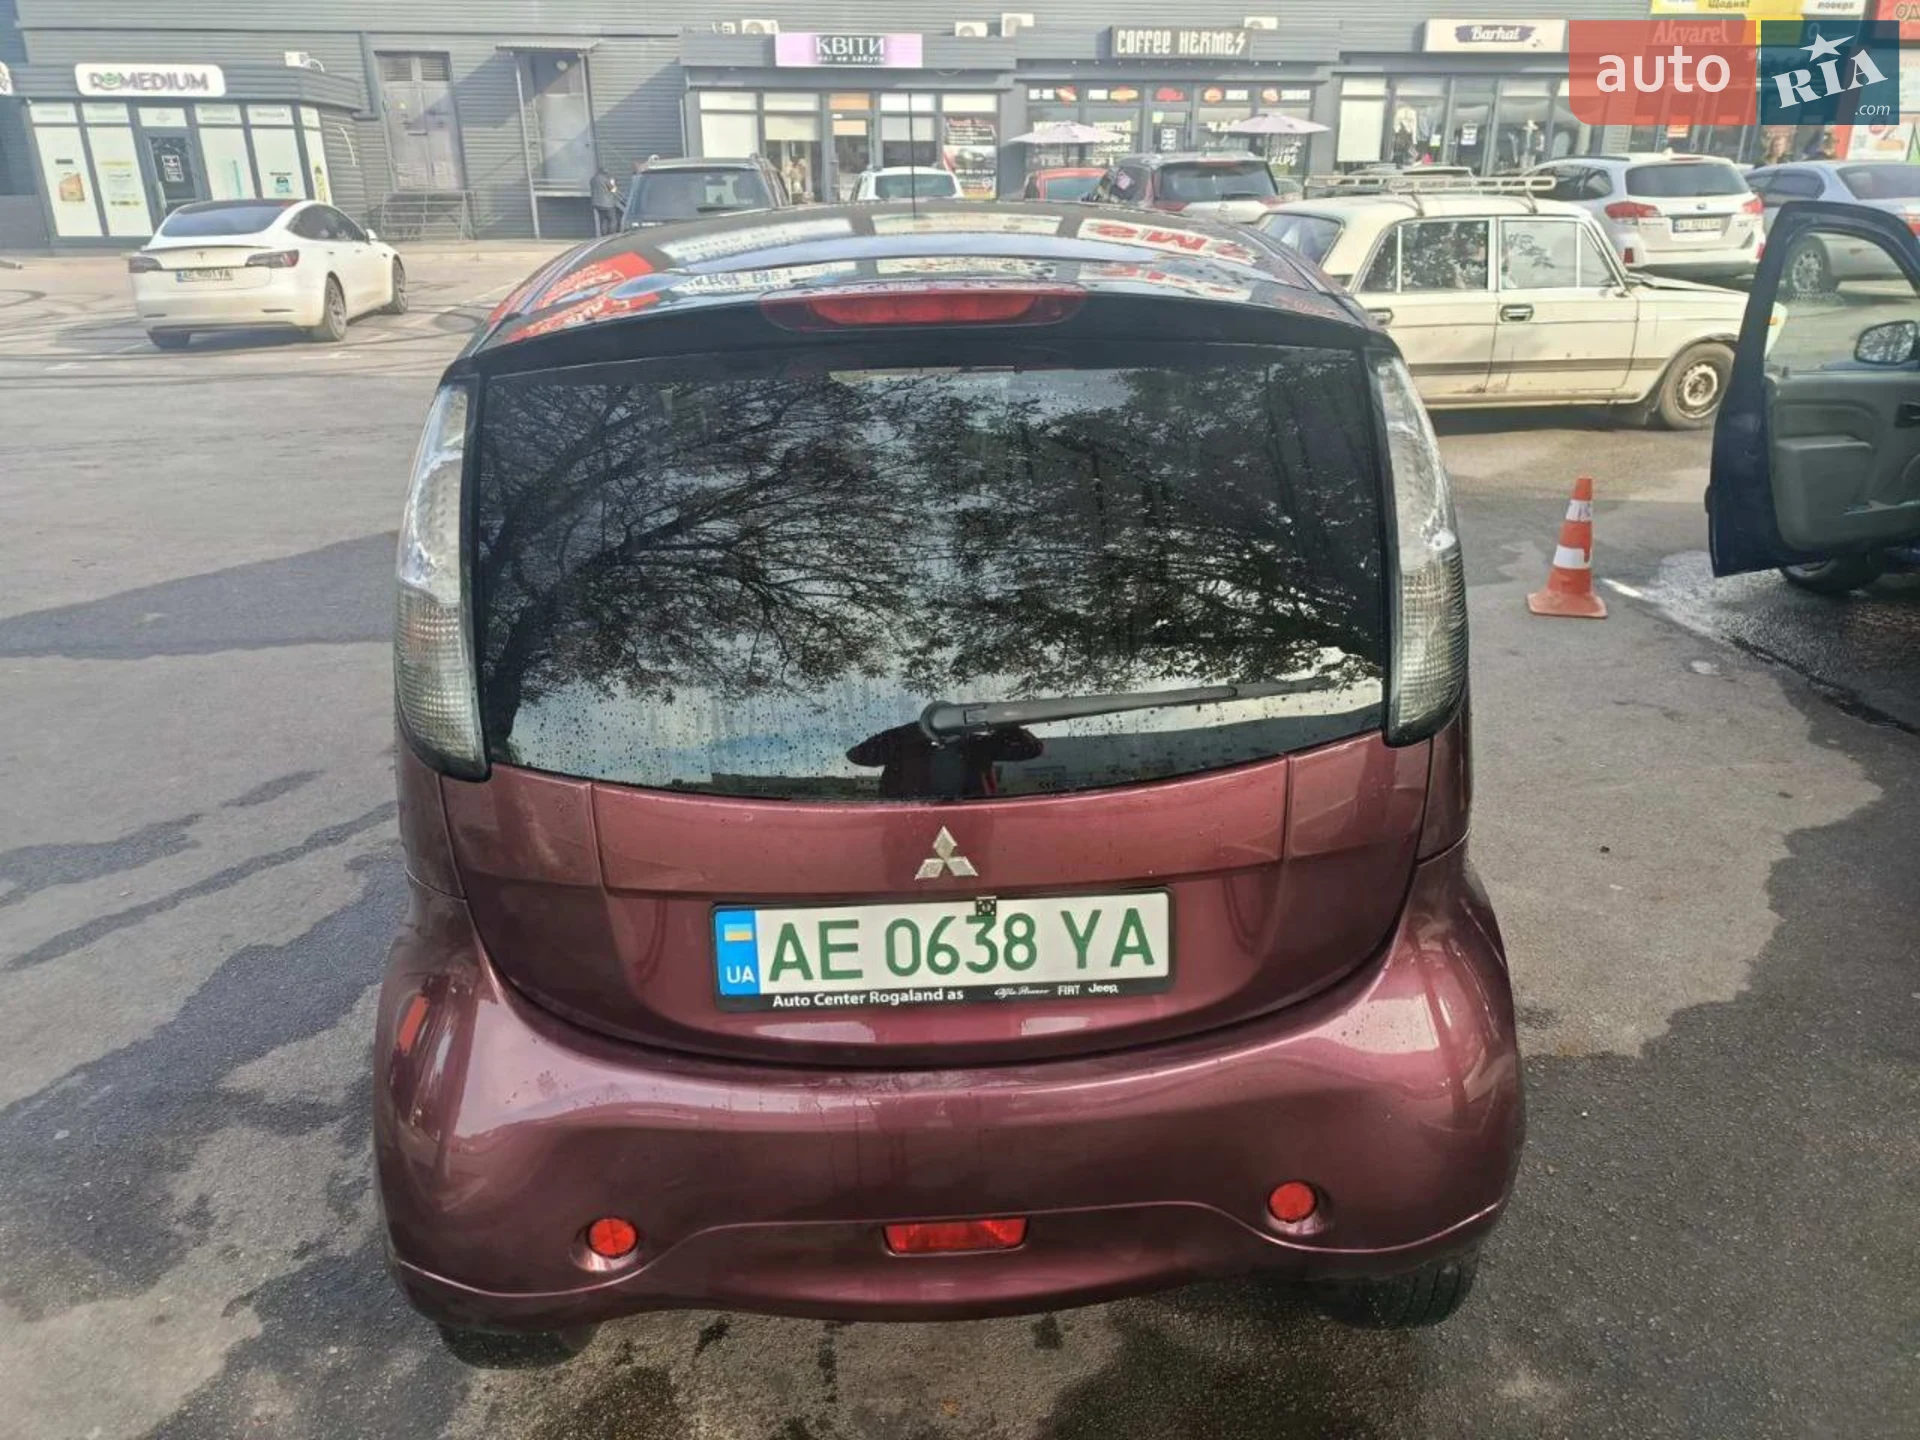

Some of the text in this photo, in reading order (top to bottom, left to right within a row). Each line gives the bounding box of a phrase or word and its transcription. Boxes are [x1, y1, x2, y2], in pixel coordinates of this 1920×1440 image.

[1652, 19, 1729, 44] Akvarel
[815, 36, 885, 55] КВІТИ
[1179, 30, 1246, 55] HERMES
[768, 907, 1155, 982] AE 0638 YA
[726, 965, 756, 985] UA
[772, 987, 965, 1008] Auto Center Rogaland as
[1056, 983, 1081, 996] FIAT
[1087, 982, 1119, 994] Jeep
